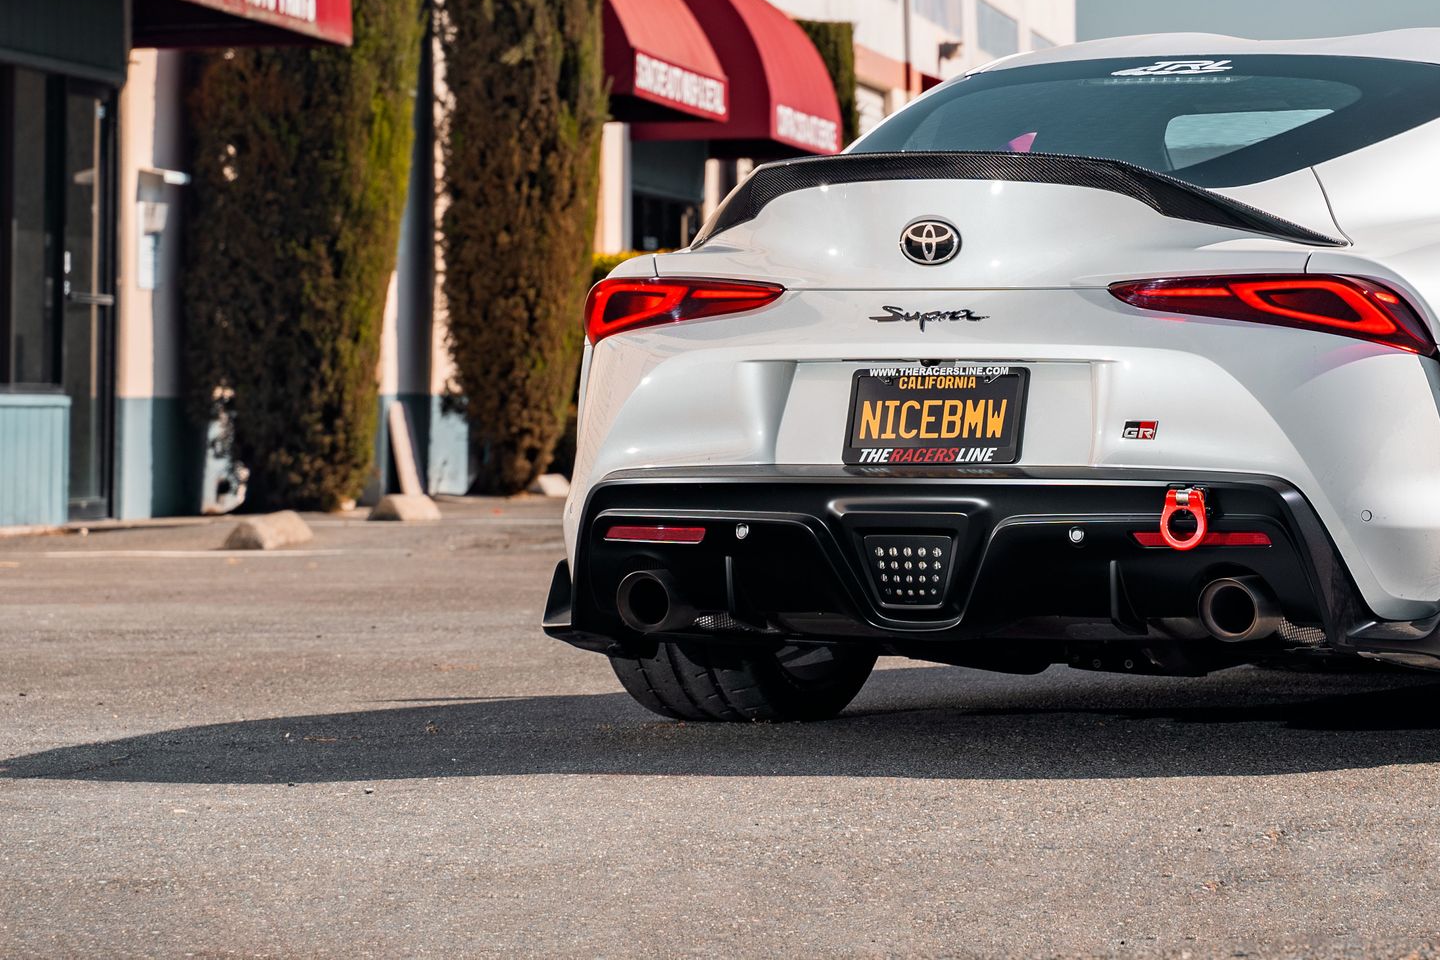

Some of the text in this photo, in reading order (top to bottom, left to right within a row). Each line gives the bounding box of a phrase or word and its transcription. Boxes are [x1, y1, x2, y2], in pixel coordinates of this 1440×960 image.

[868, 305, 990, 332] Supra
[869, 366, 1009, 377] WWW.THERACERSLINE.COM
[898, 376, 976, 389] CALIFORNIA
[859, 399, 1008, 439] NICEBMW
[1123, 426, 1154, 439] GR
